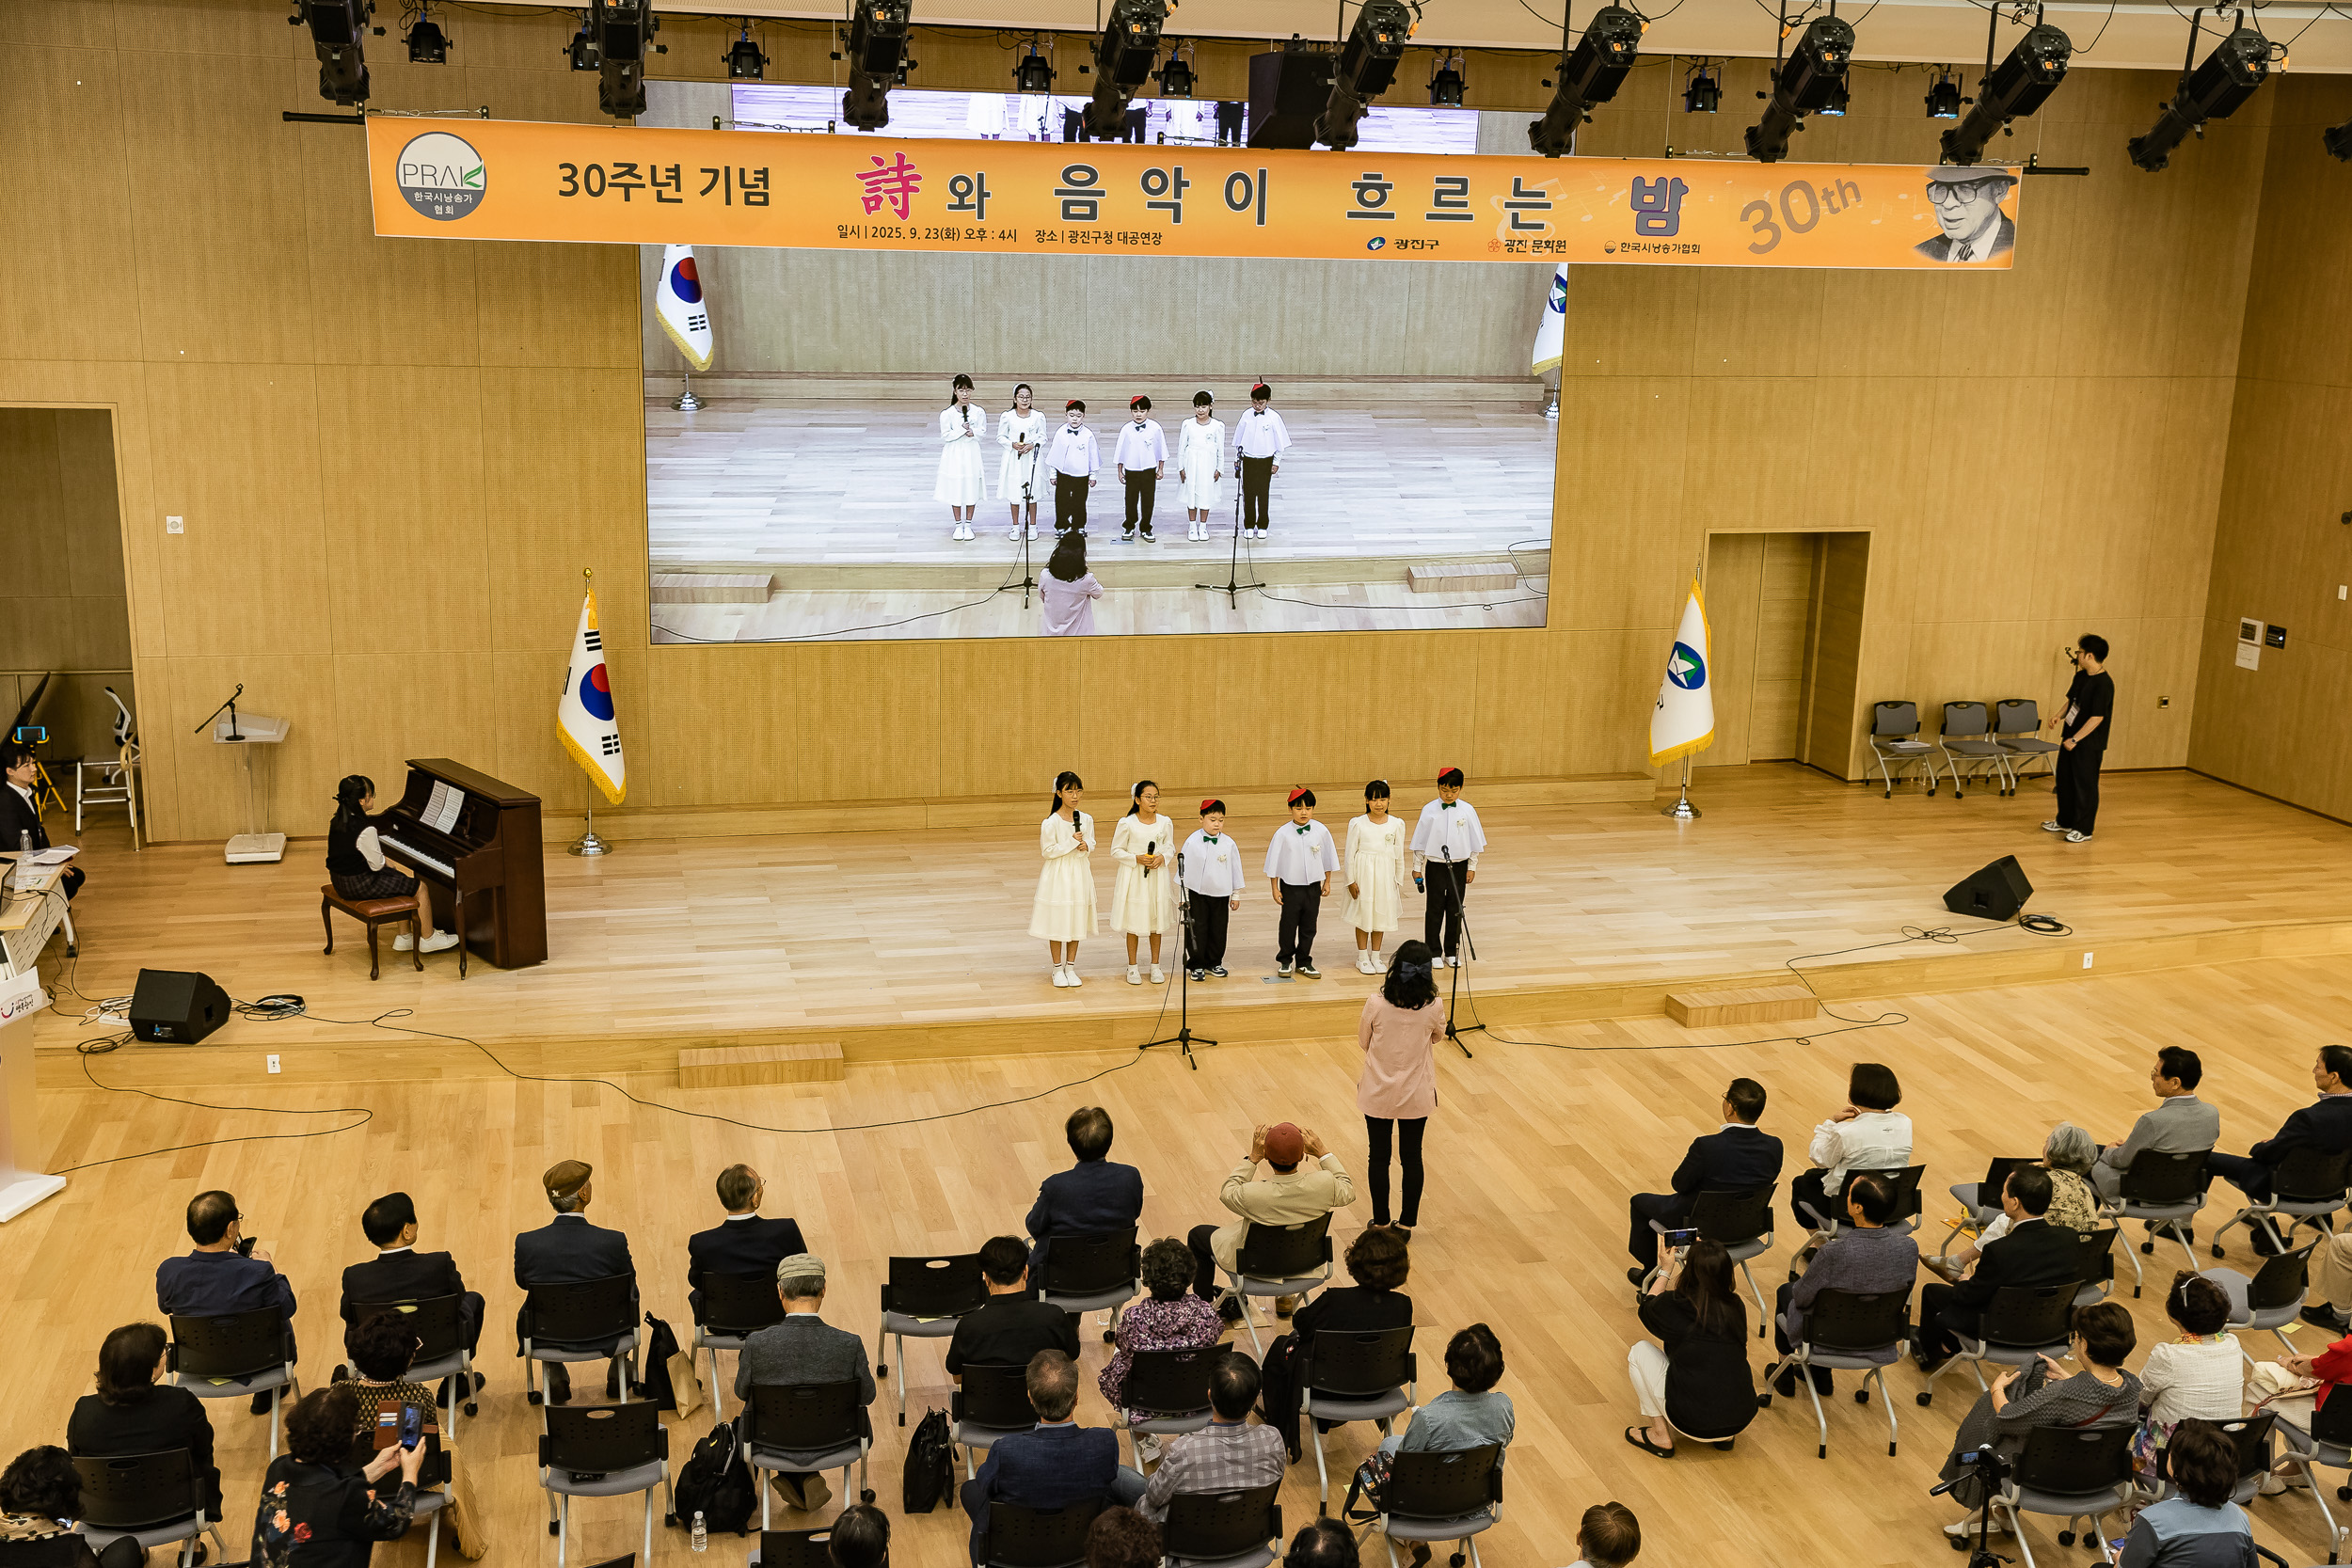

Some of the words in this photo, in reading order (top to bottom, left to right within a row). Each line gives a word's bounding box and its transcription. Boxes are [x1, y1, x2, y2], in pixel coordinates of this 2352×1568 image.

[414, 191, 472, 203] 한국시낭송가
[559, 162, 684, 203] 30주년
[699, 166, 770, 206] 기념
[1630, 176, 1689, 236] 밤
[434, 204, 453, 215] 협회
[1740, 179, 1863, 255] 30th
[837, 224, 861, 239] 일시
[925, 227, 961, 241] 23(화)
[964, 228, 988, 242] 오후
[998, 229, 1017, 243] 4시
[1035, 230, 1058, 244] 장소
[1068, 230, 1113, 245] 광진구청
[1117, 231, 1162, 245] 대공연장
[1393, 239, 1440, 250] 광진구
[1504, 239, 1527, 253] 광진
[1532, 240, 1566, 254] 문화원
[1620, 242, 1701, 254] 한국시낭송가협회
